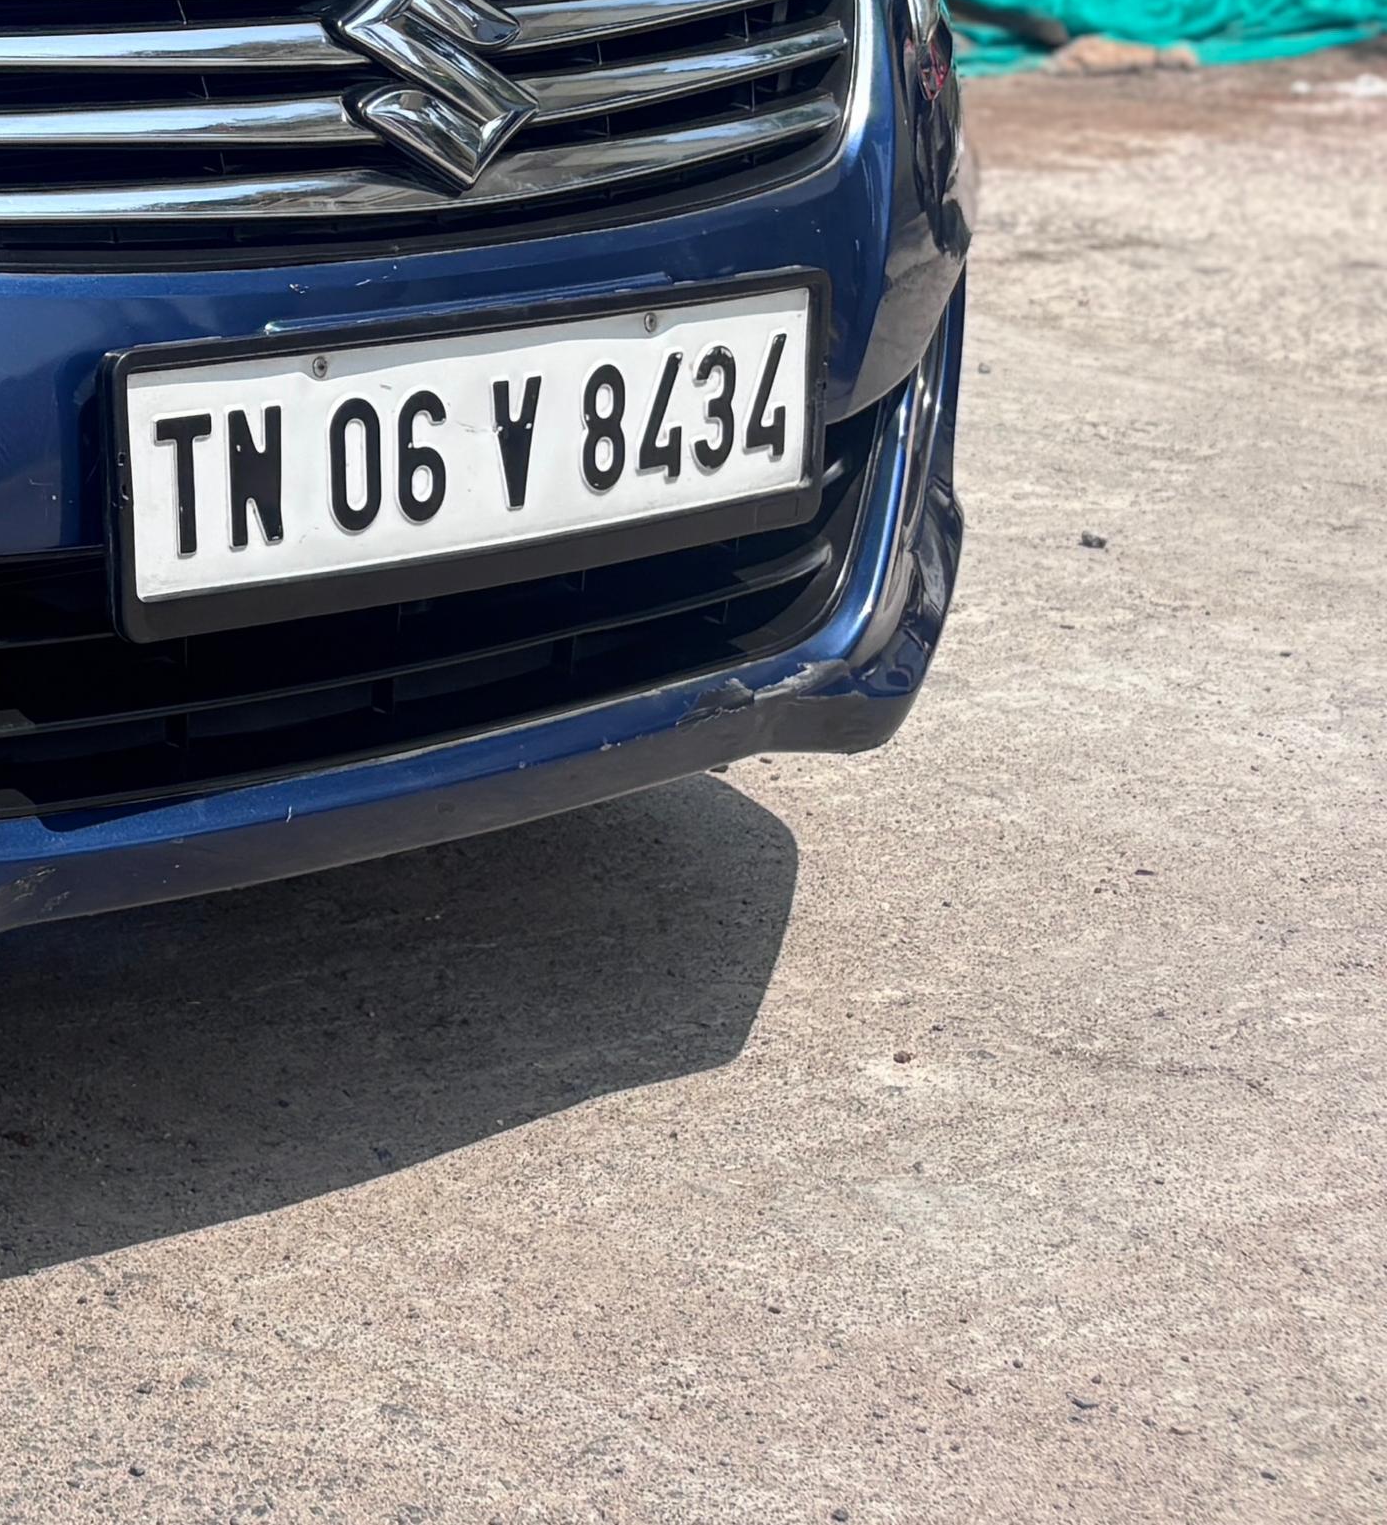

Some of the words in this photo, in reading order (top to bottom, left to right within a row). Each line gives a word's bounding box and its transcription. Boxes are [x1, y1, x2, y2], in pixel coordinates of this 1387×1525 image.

[153, 404, 283, 556] TN
[329, 389, 447, 533] 06
[491, 375, 542, 511] V
[582, 332, 788, 492] 8434
